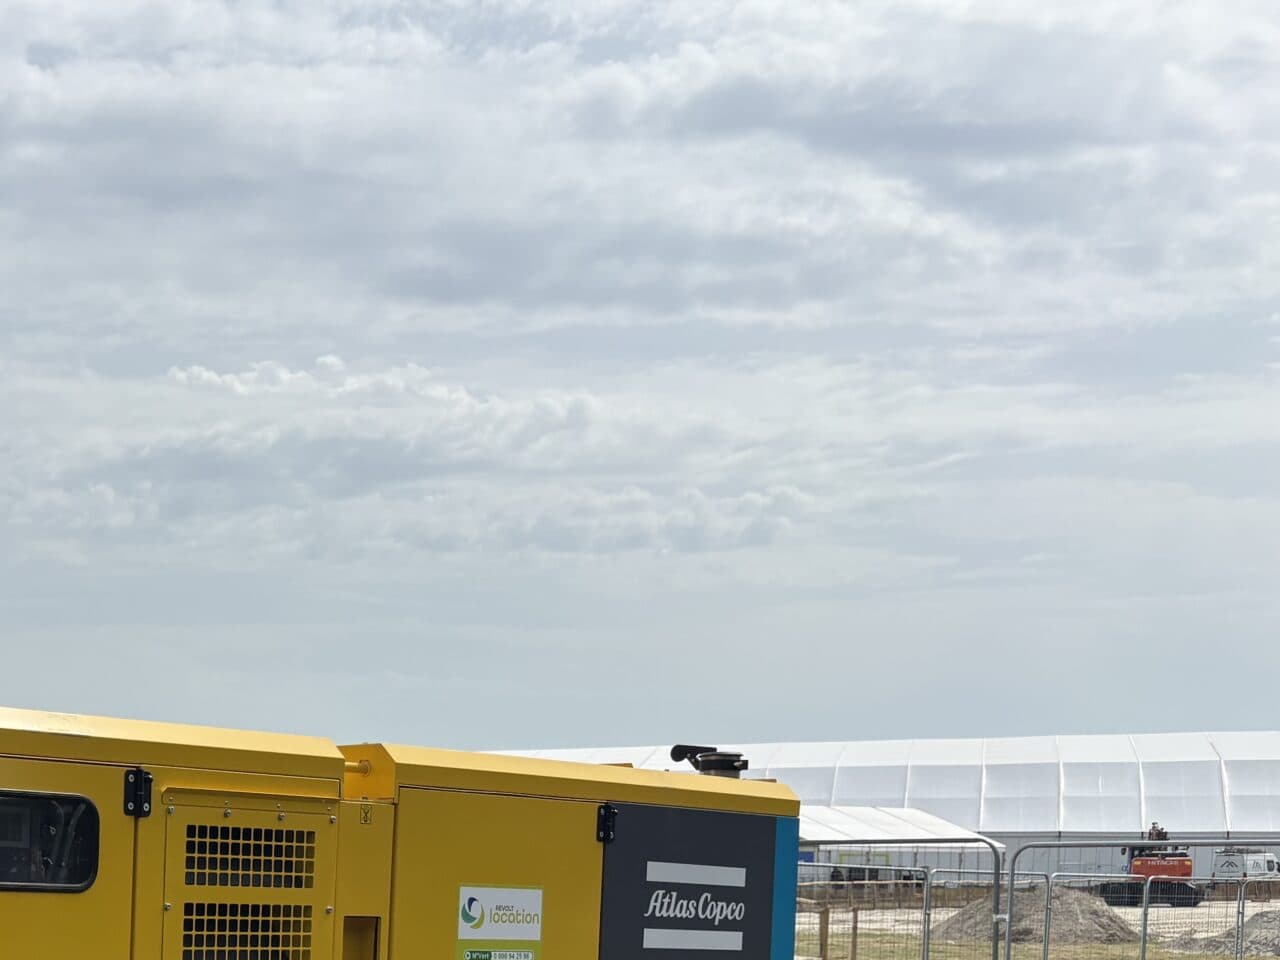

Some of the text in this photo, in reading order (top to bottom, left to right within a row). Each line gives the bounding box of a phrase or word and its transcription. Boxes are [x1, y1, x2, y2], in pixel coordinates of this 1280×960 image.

[489, 907, 540, 925] location
[644, 889, 745, 926] Atlas Copco
